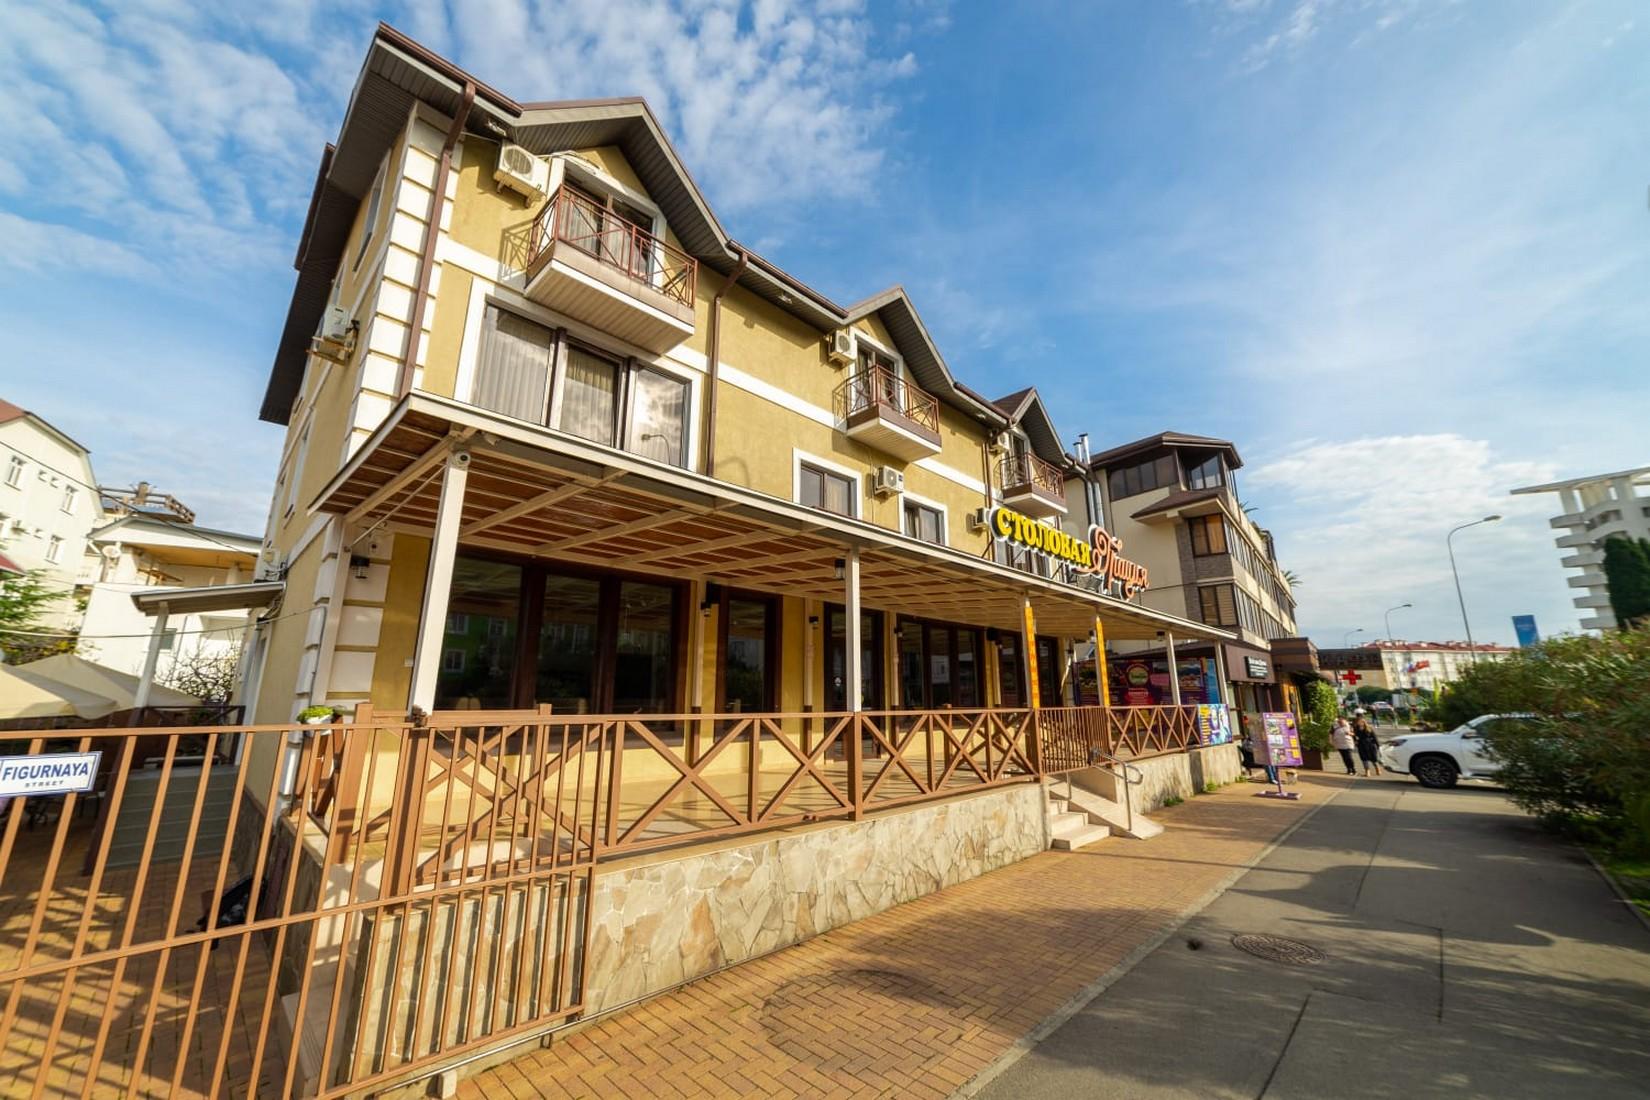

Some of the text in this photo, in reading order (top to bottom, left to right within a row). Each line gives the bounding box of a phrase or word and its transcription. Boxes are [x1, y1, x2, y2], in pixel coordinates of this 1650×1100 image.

[996, 507, 1092, 567] СТОЛОВАЯ
[2, 762, 89, 780] FIGURNAYA
[25, 780, 64, 788] STREET
